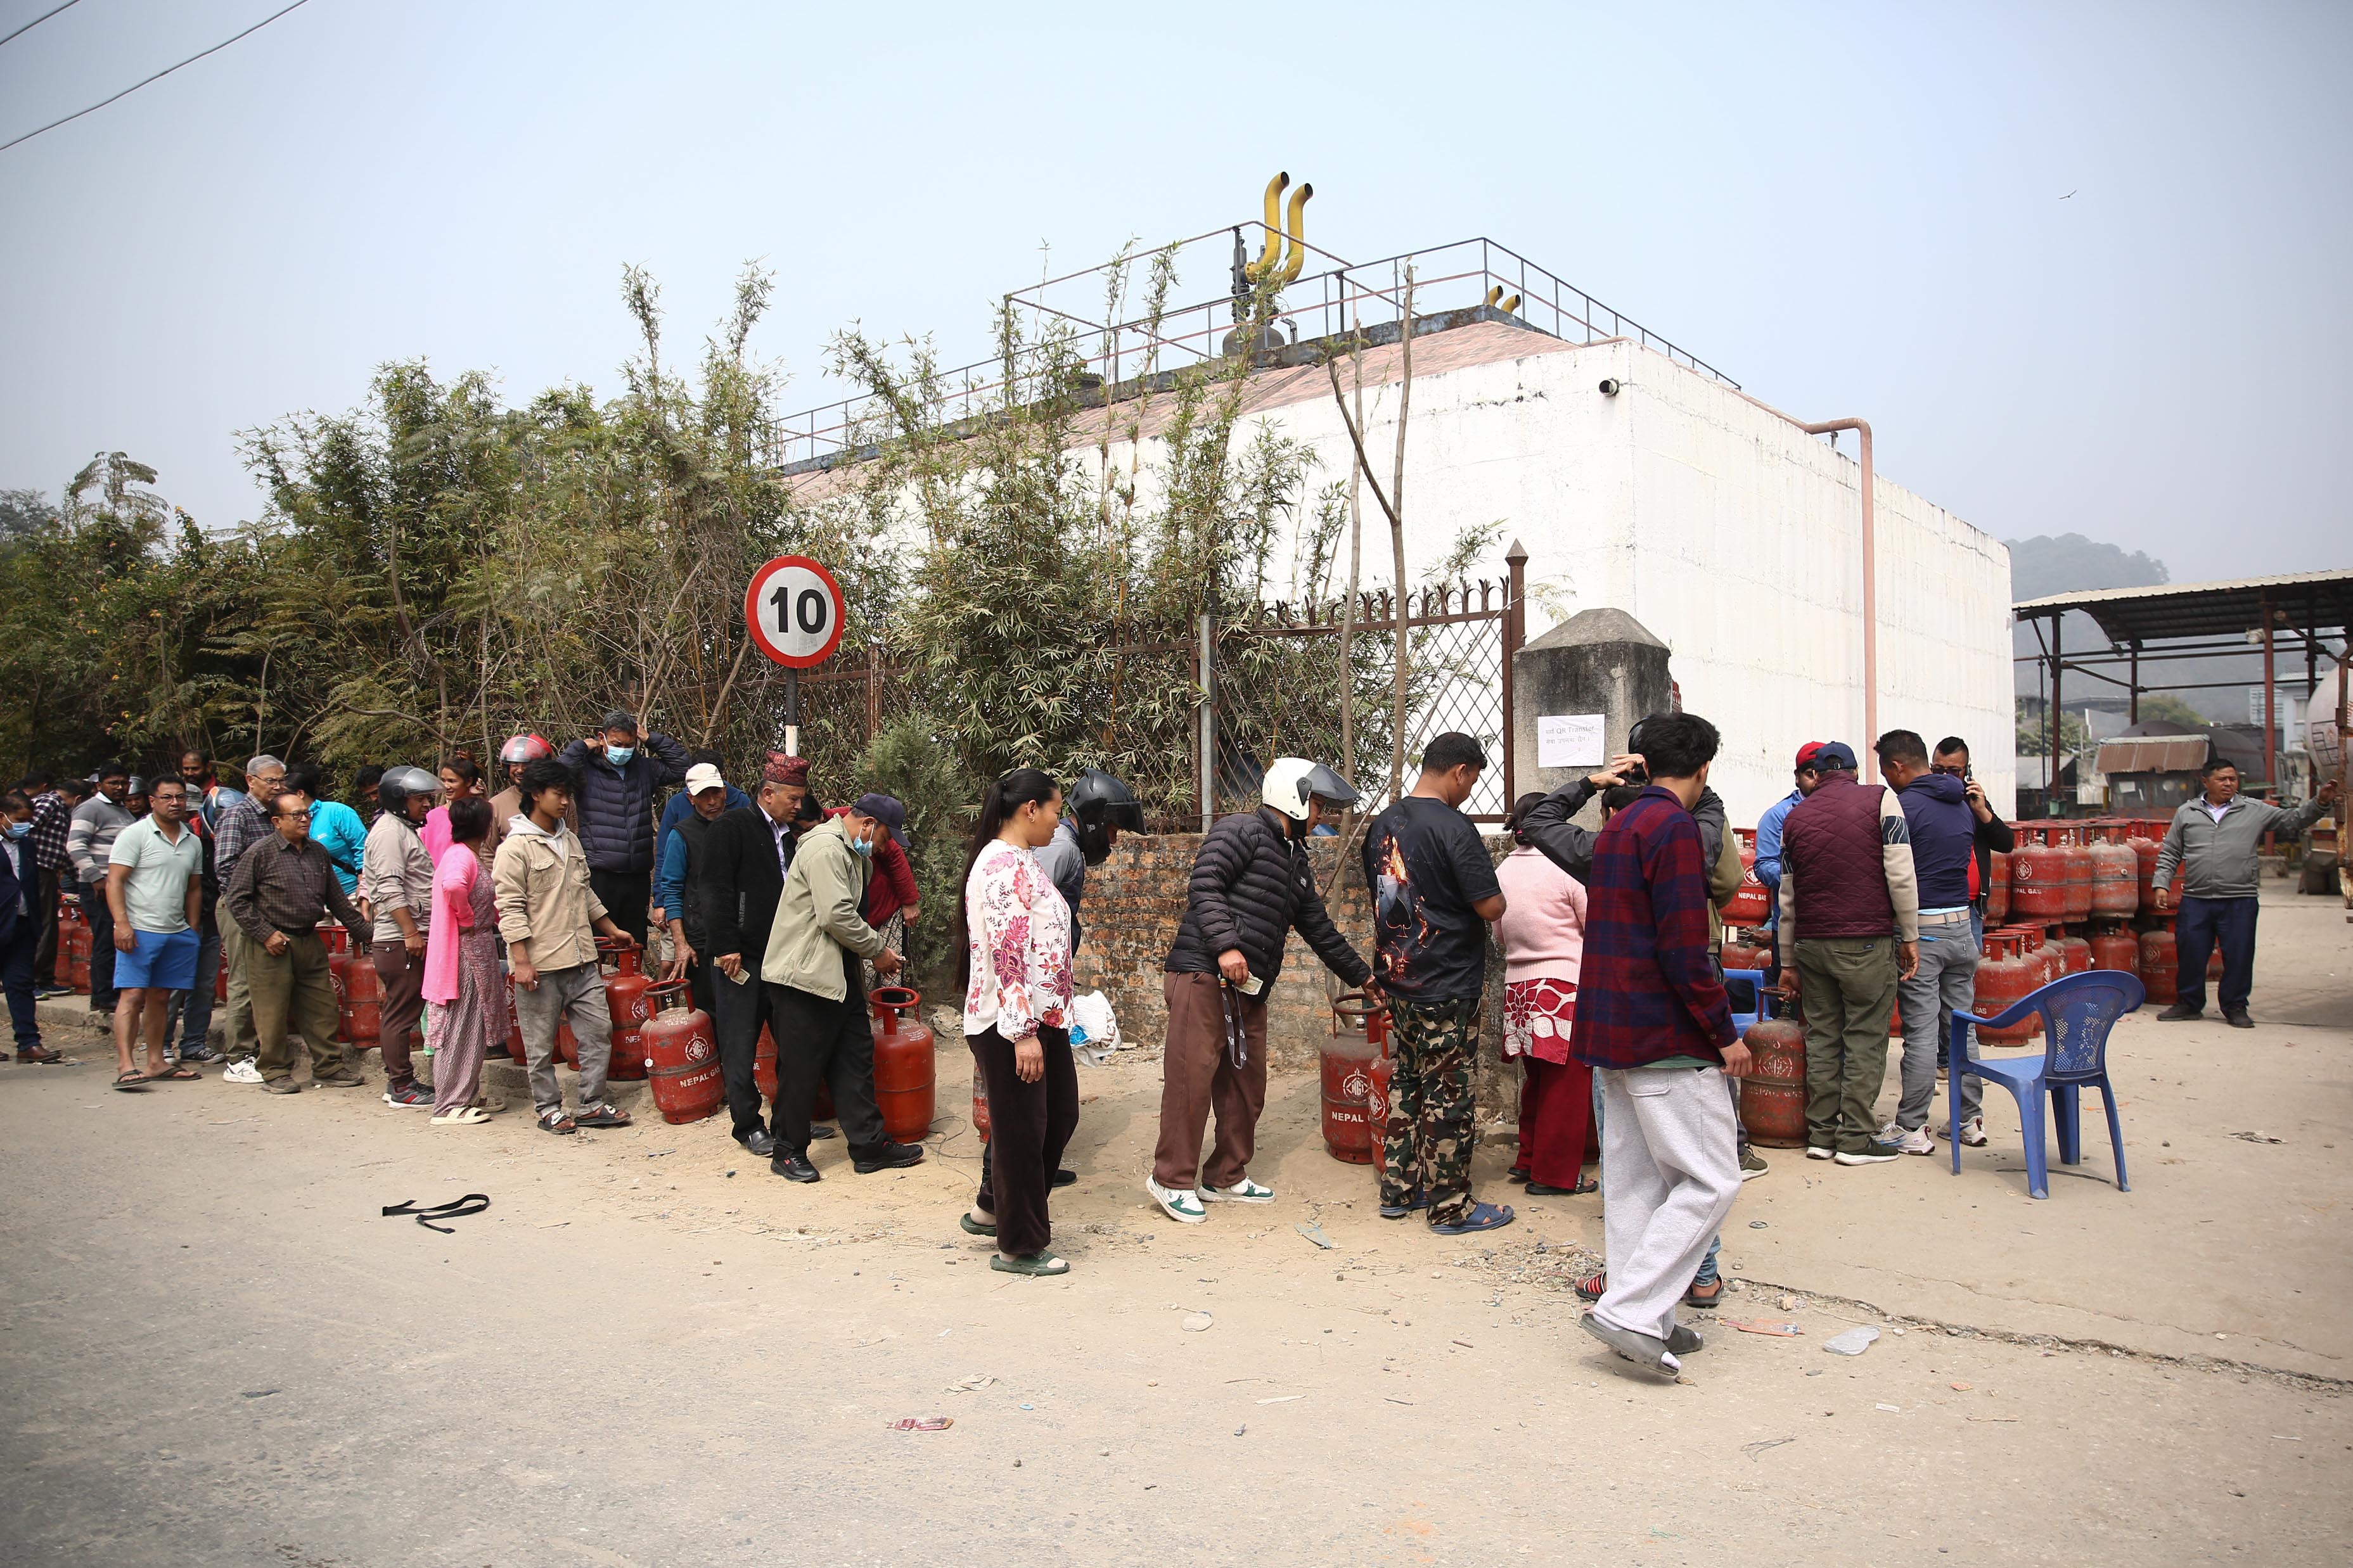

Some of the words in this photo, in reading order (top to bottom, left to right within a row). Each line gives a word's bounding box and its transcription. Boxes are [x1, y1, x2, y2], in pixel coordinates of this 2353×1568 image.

[771, 587, 826, 634] 10
[1378, 877, 1384, 888] A
[1738, 892, 1757, 900] NEPAL
[679, 1073, 709, 1088] NEPAL
[710, 1066, 721, 1076] GAS
[1331, 1111, 1364, 1123] NEPAL
